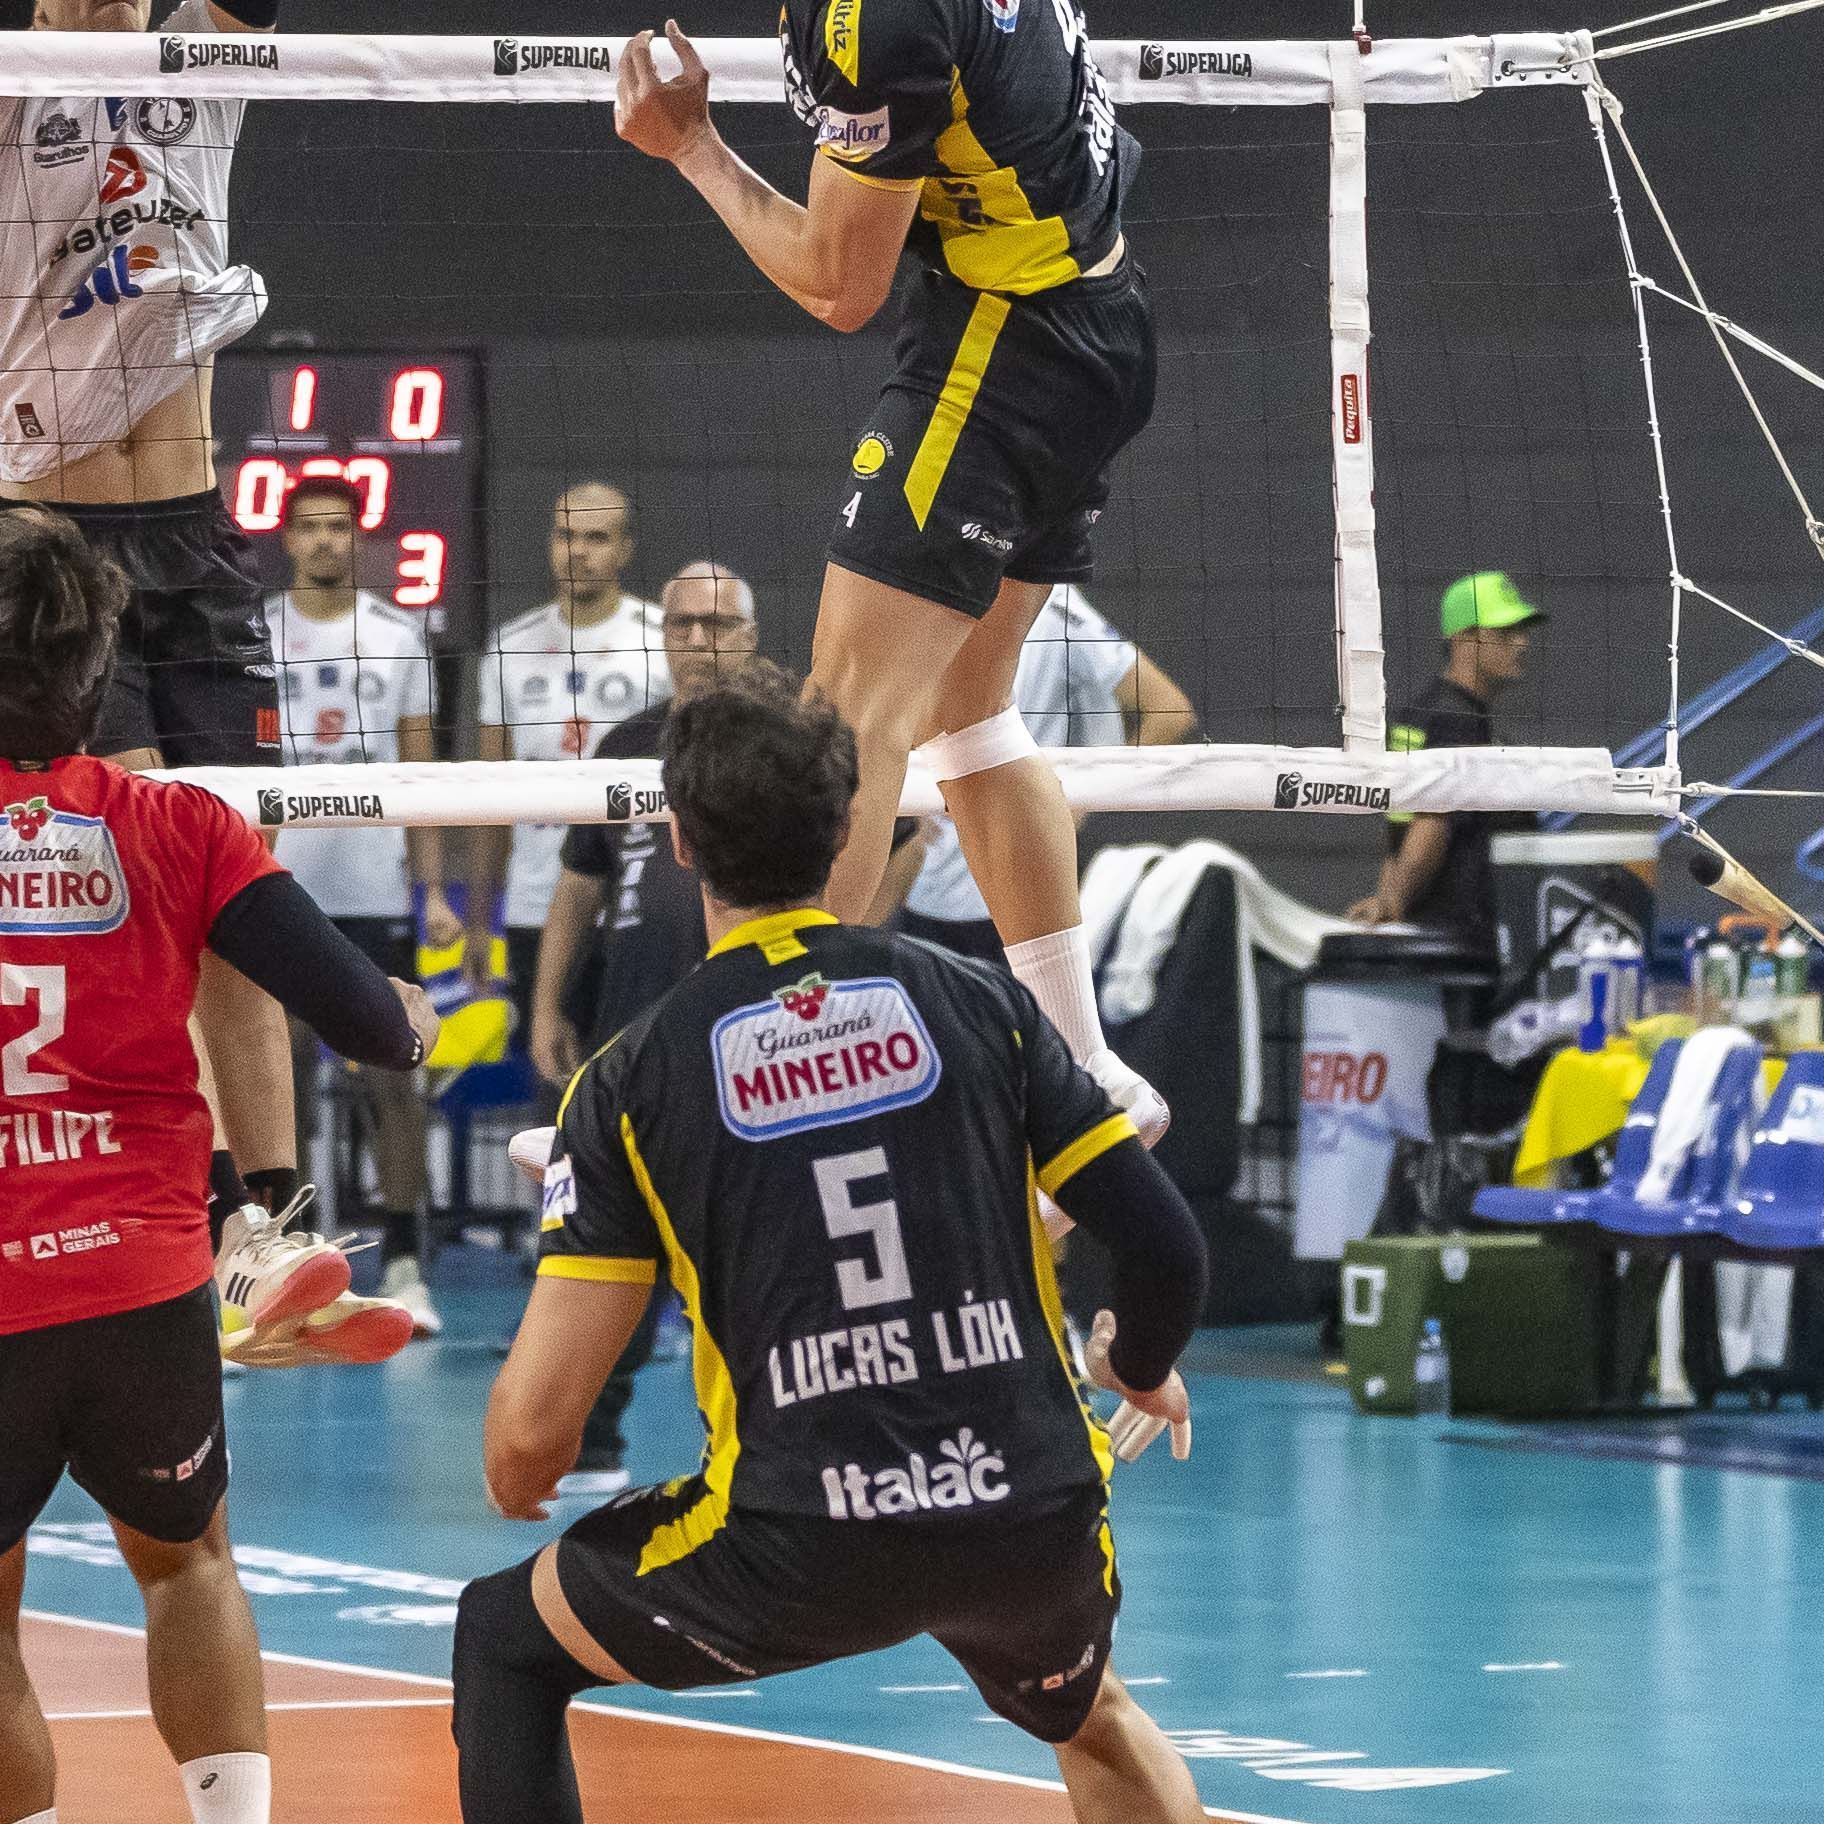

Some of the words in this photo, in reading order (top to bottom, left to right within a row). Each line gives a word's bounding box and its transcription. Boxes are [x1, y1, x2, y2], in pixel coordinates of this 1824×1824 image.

[187, 42, 280, 71] SUPERLIGA
[520, 45, 612, 74] SUPERLIGA
[1165, 51, 1253, 78] SUPERLIGA
[291, 366, 317, 431] 1
[390, 367, 444, 442] 0
[842, 491, 862, 528] 4
[394, 531, 445, 606] 3
[287, 794, 385, 822] SUPERLIGA
[1300, 780, 1391, 811] SUPERLIGA
[0, 963, 69, 1096] 2
[733, 1031, 920, 1113] MINEIRO
[1302, 1050, 1388, 1105] EIRO
[58, 1221, 111, 1243] MINAS
[62, 1232, 121, 1254] GERAIS
[812, 1145, 913, 1310] 5
[768, 1318, 919, 1408] LUCAS
[821, 1452, 1011, 1520] Italac
